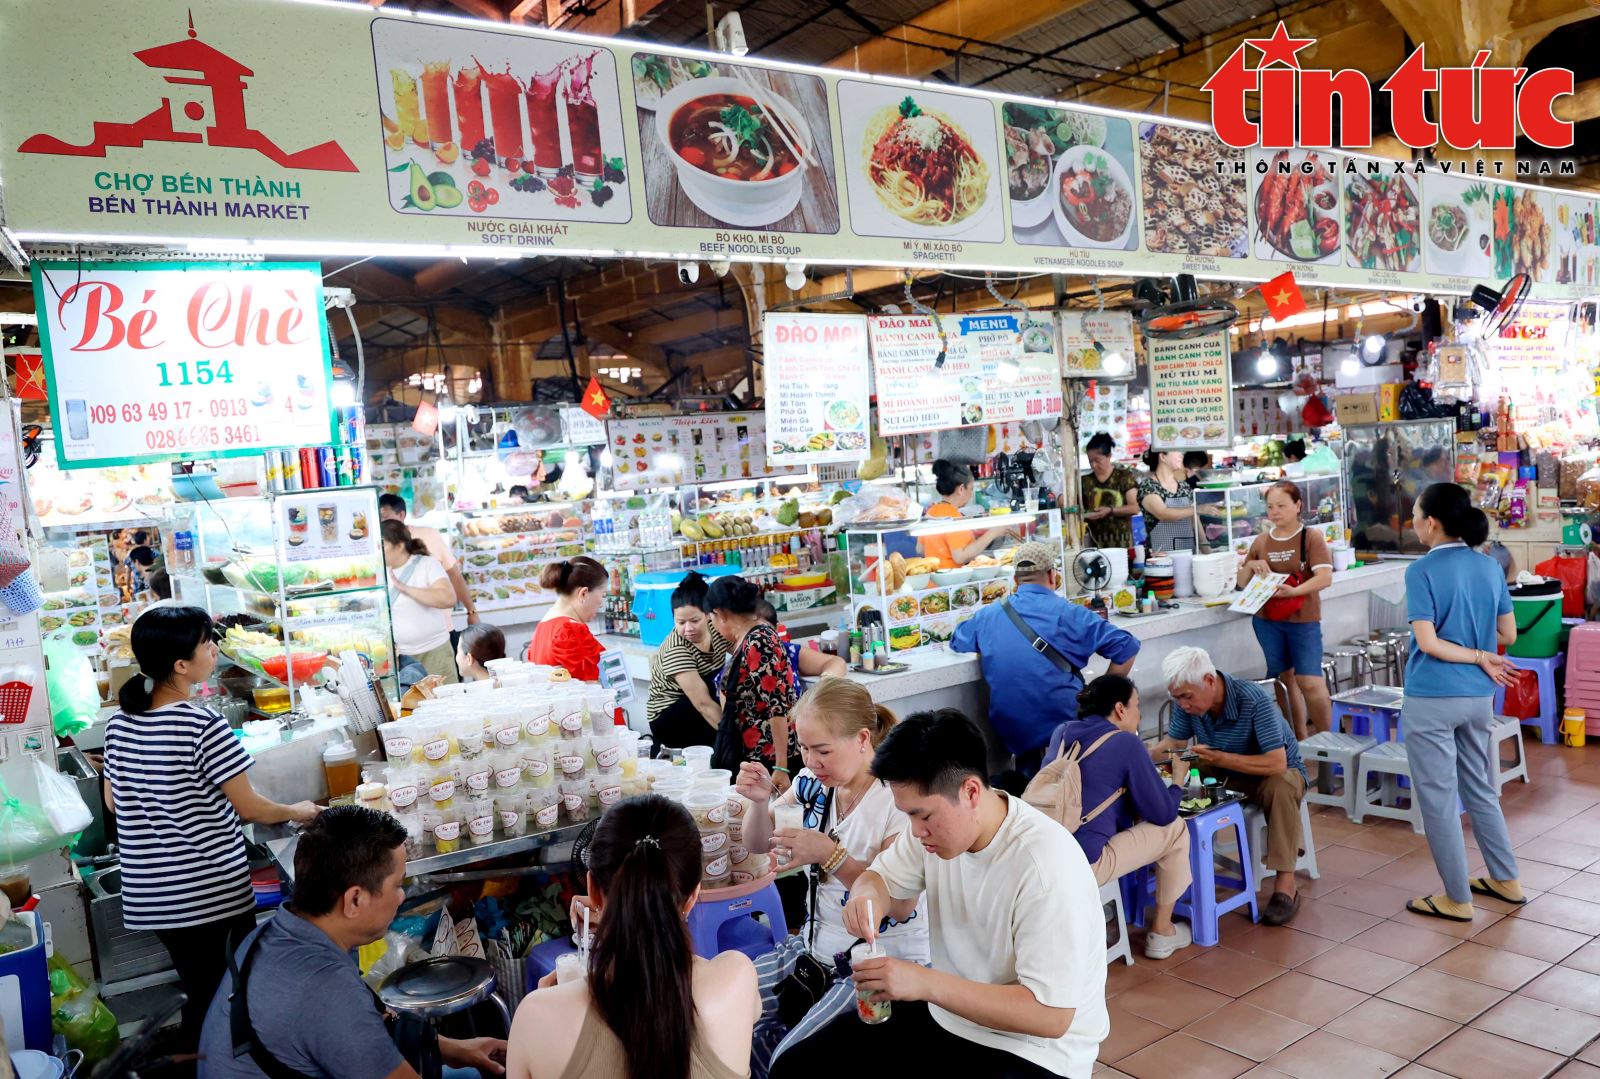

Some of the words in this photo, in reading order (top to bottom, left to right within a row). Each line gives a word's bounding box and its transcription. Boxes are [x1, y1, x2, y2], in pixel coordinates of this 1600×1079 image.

[95, 171, 156, 196] CHỢ
[219, 175, 302, 199] THÀNH
[143, 196, 219, 217] THÀNH
[225, 202, 311, 221] MARKET
[467, 220, 505, 233] NƯỚC
[509, 222, 534, 234] GIẢI
[537, 223, 568, 235] KHÁT
[482, 233, 514, 244] SOFT
[517, 235, 555, 246] DRINK
[715, 231, 731, 243] BÒ
[700, 242, 726, 253] BEEF
[728, 243, 775, 255] NOODLES
[776, 247, 802, 257] SOUP
[913, 250, 955, 262] SPAGHETTI
[1033, 256, 1075, 267] VIETNAMESE
[1076, 258, 1107, 268] NOODLES
[1108, 260, 1124, 269] SOUP
[58, 281, 165, 352] Bé
[187, 281, 310, 349] Chè
[968, 319, 1008, 330] MENU
[1178, 343, 1201, 351] CANH
[1203, 341, 1221, 349] CUA
[1178, 351, 1201, 360] CANH
[1204, 349, 1222, 358] TÔM
[156, 360, 234, 387] 1154
[1182, 379, 1199, 387] NAM
[1201, 378, 1223, 386] VANG
[122, 403, 143, 423] 63
[148, 402, 168, 421] 49
[174, 401, 192, 420] 17
[210, 398, 248, 418] 0913
[921, 412, 940, 421] HEO
